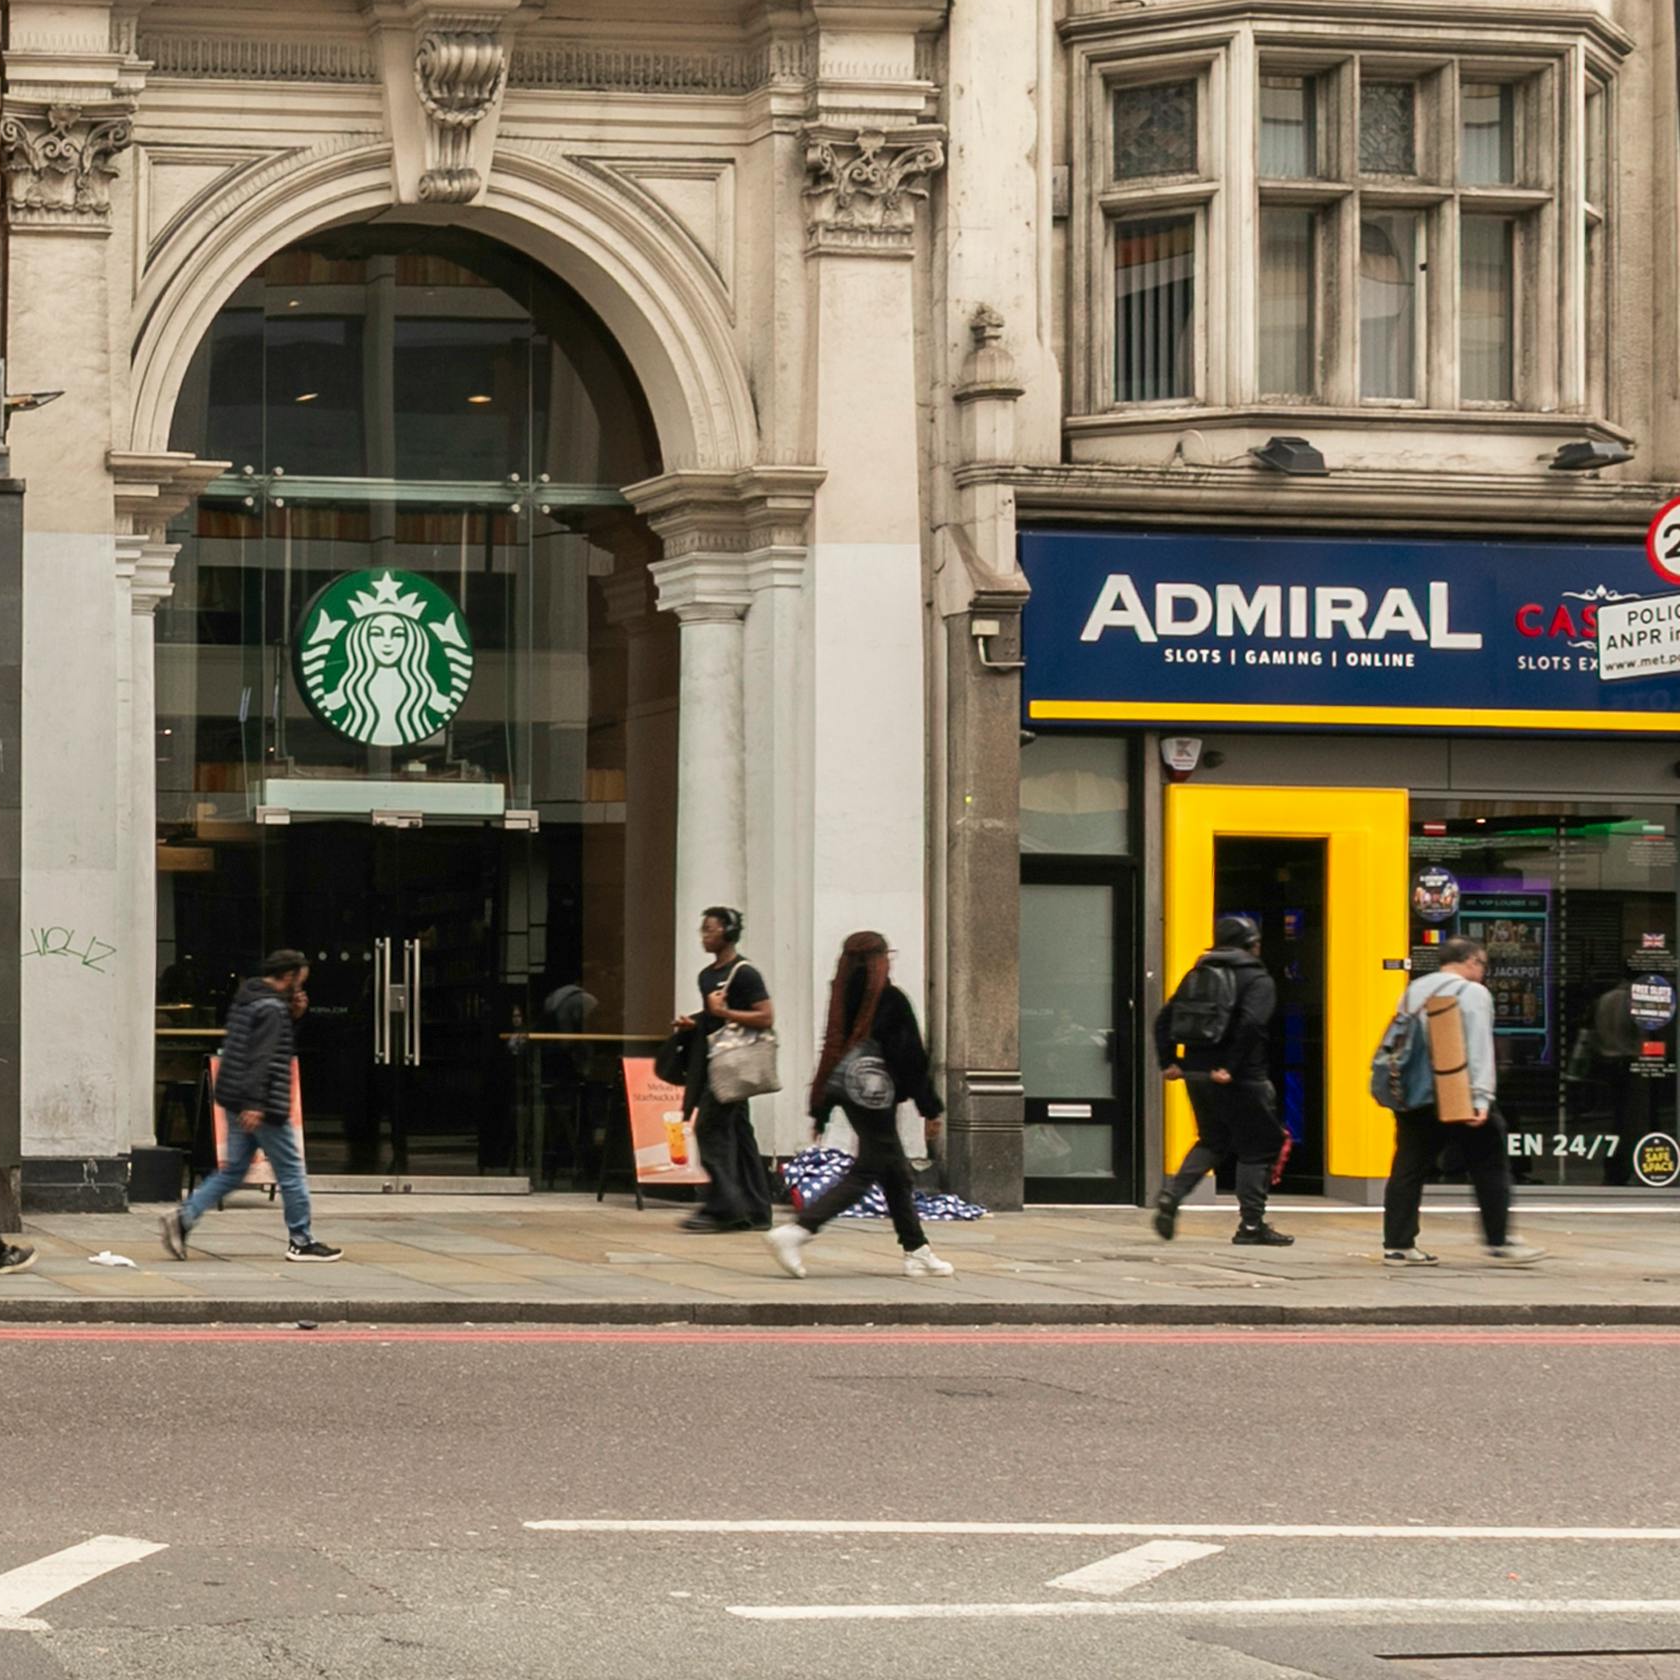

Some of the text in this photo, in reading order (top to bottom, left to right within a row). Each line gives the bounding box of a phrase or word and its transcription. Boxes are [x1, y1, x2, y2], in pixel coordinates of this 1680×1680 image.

[1079, 573, 1483, 650] ADMIRAL
[1606, 628, 1662, 651] ANPR
[1164, 647, 1415, 668] SLOTS GAMING ONLINE
[1517, 655, 1571, 670] SLOTS
[1494, 966, 1541, 977] JACKPOT
[1553, 1134, 1620, 1160] 24/7
[1645, 1152, 1671, 1162] SAFE
[1642, 1161, 1675, 1174] SPACE
